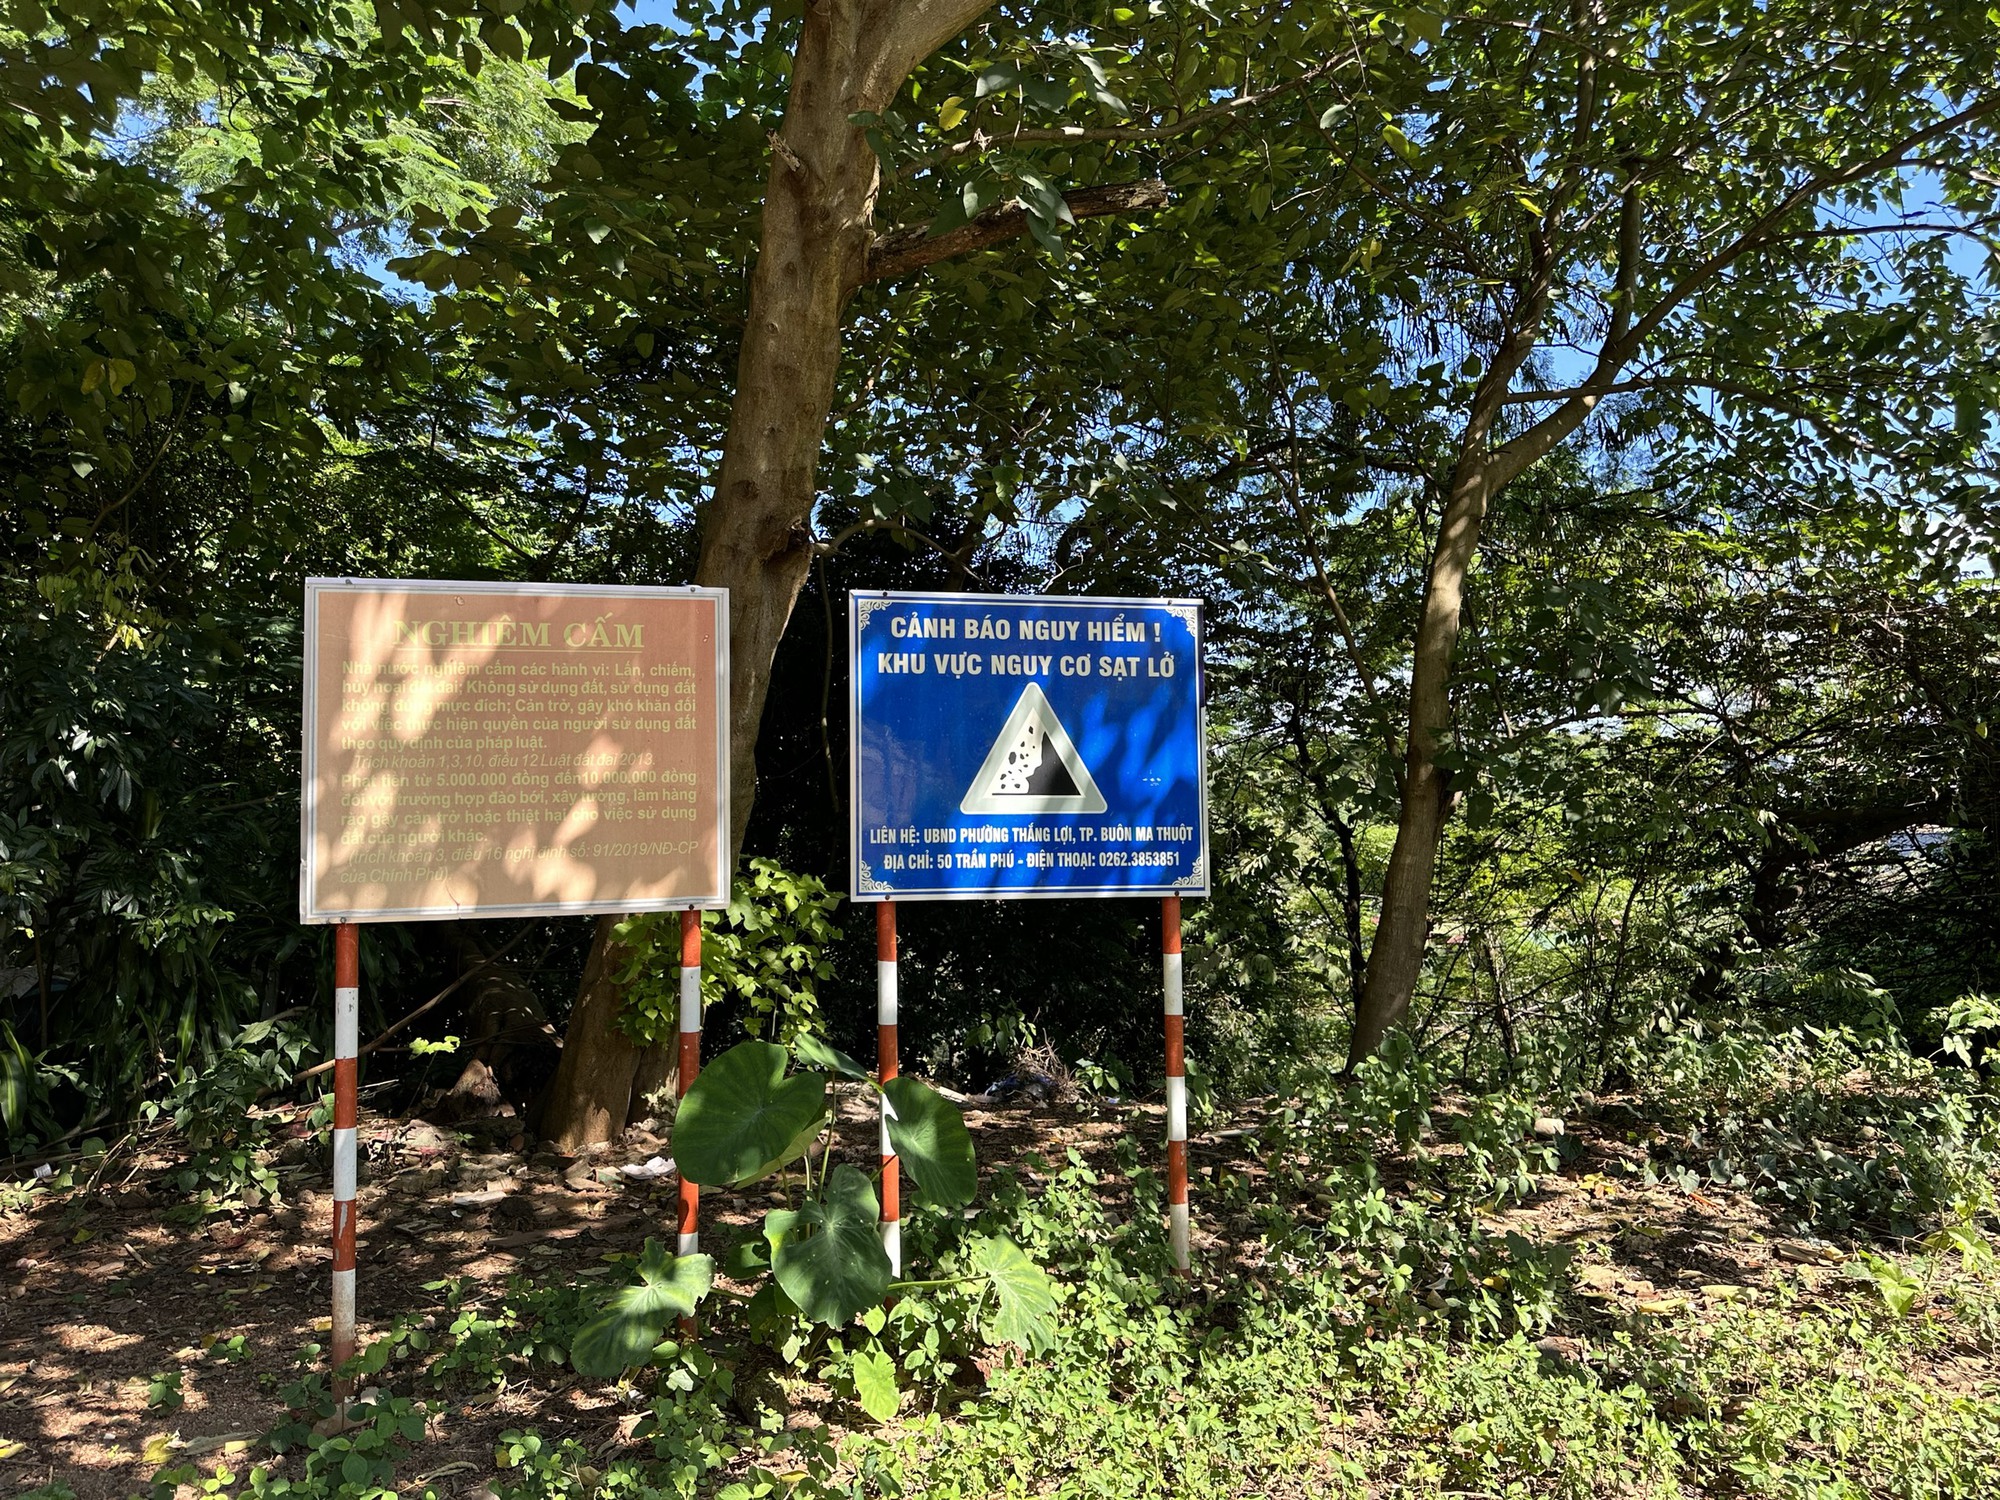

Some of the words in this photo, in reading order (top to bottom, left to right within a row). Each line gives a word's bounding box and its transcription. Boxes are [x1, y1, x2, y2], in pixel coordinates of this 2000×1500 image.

[392, 614, 551, 646] NGHIÊM
[563, 612, 645, 648] CẤM
[891, 612, 955, 638] CẢNH
[964, 615, 1011, 640] BÁO
[1019, 620, 1080, 641] NGUY
[1088, 613, 1146, 642] HIỂM
[485, 659, 516, 675] cấm
[521, 663, 546, 675] các
[552, 663, 587, 675] hành
[592, 663, 609, 676] vi:
[615, 661, 645, 678] Lấn,
[650, 662, 696, 678] chiếm,
[878, 653, 925, 674] KHU
[934, 651, 982, 679] VỰC
[992, 655, 1052, 676] NGUY
[1060, 654, 1091, 677] CƠ
[1100, 657, 1140, 681] SẠT
[1148, 652, 1174, 678] LỞ
[374, 681, 405, 697] hoại
[467, 680, 515, 696] Không
[519, 681, 539, 694] sử
[541, 682, 577, 696] dụng
[581, 678, 607, 696] đất,
[610, 681, 630, 694] sử
[634, 682, 669, 696] dụng
[674, 679, 696, 694] đất
[342, 699, 390, 714] không
[394, 699, 432, 714] đúg
[436, 703, 470, 715] mực
[474, 699, 511, 713] đích;
[515, 699, 544, 712] Cản
[549, 700, 573, 713] trở,
[578, 700, 603, 714] gây
[607, 700, 633, 712] khó
[637, 700, 671, 712] khăn
[674, 698, 696, 712] đối
[371, 718, 402, 733] việc
[447, 718, 478, 733] hiện
[483, 714, 529, 732] quyền
[533, 717, 559, 730] của
[564, 718, 608, 732] người
[612, 717, 631, 730] sử
[635, 718, 670, 732] dụng
[675, 715, 696, 730] đất
[342, 737, 375, 750] theo
[378, 739, 406, 752] quy
[409, 736, 442, 752] định
[446, 735, 472, 749] của
[476, 737, 512, 751] pháp
[516, 735, 547, 751] luật.
[392, 754, 435, 768] khoản
[488, 752, 518, 767] điều
[522, 754, 538, 766] 12
[541, 754, 571, 768] Luật
[573, 751, 595, 766] đất
[597, 753, 618, 766] đai
[620, 752, 655, 766] 2013.
[415, 773, 432, 787] từ
[437, 773, 506, 786] 5.000.000
[512, 769, 549, 788] đồng
[661, 768, 696, 786] đồng
[398, 794, 450, 808] trường
[455, 792, 484, 808] hợp
[488, 792, 516, 804] đào
[520, 791, 548, 804] bới,
[552, 792, 577, 805] xây
[634, 789, 658, 801] làm
[663, 789, 696, 803] hàng
[404, 811, 432, 825] cản
[437, 811, 460, 824] trở
[465, 810, 501, 826] hoặc
[507, 809, 540, 825] thiệt
[545, 809, 567, 824] hại
[572, 809, 598, 821] cho
[604, 808, 633, 823] việc
[638, 806, 657, 820] sử
[661, 808, 696, 821] dụng
[399, 830, 444, 846] người
[448, 829, 488, 842] khác.
[870, 826, 896, 843] LIÊN
[901, 825, 920, 846] HỆ:
[924, 828, 956, 843] UBND
[960, 824, 1008, 842] PHƯỜNG
[1012, 823, 1050, 842] THẮNG
[1054, 825, 1076, 845] LỢI,
[1079, 827, 1097, 841] TP.
[1101, 824, 1132, 841] BUÔN
[1136, 827, 1153, 841] MA
[1156, 824, 1193, 844] THUỘT
[451, 845, 481, 861] điều
[486, 848, 502, 860] 16
[570, 842, 589, 858] số:
[593, 841, 698, 856] 91/2019/NĐ-CP
[884, 855, 905, 873] ĐỊA
[908, 850, 933, 869] CHỈ:
[937, 854, 952, 869] 50
[956, 848, 986, 868] TRẦN
[990, 850, 1014, 868] PHÚ
[1026, 849, 1053, 870] ĐIỆN
[1058, 852, 1095, 870] THOẠI:
[1099, 852, 1179, 866] 0262.3853851
